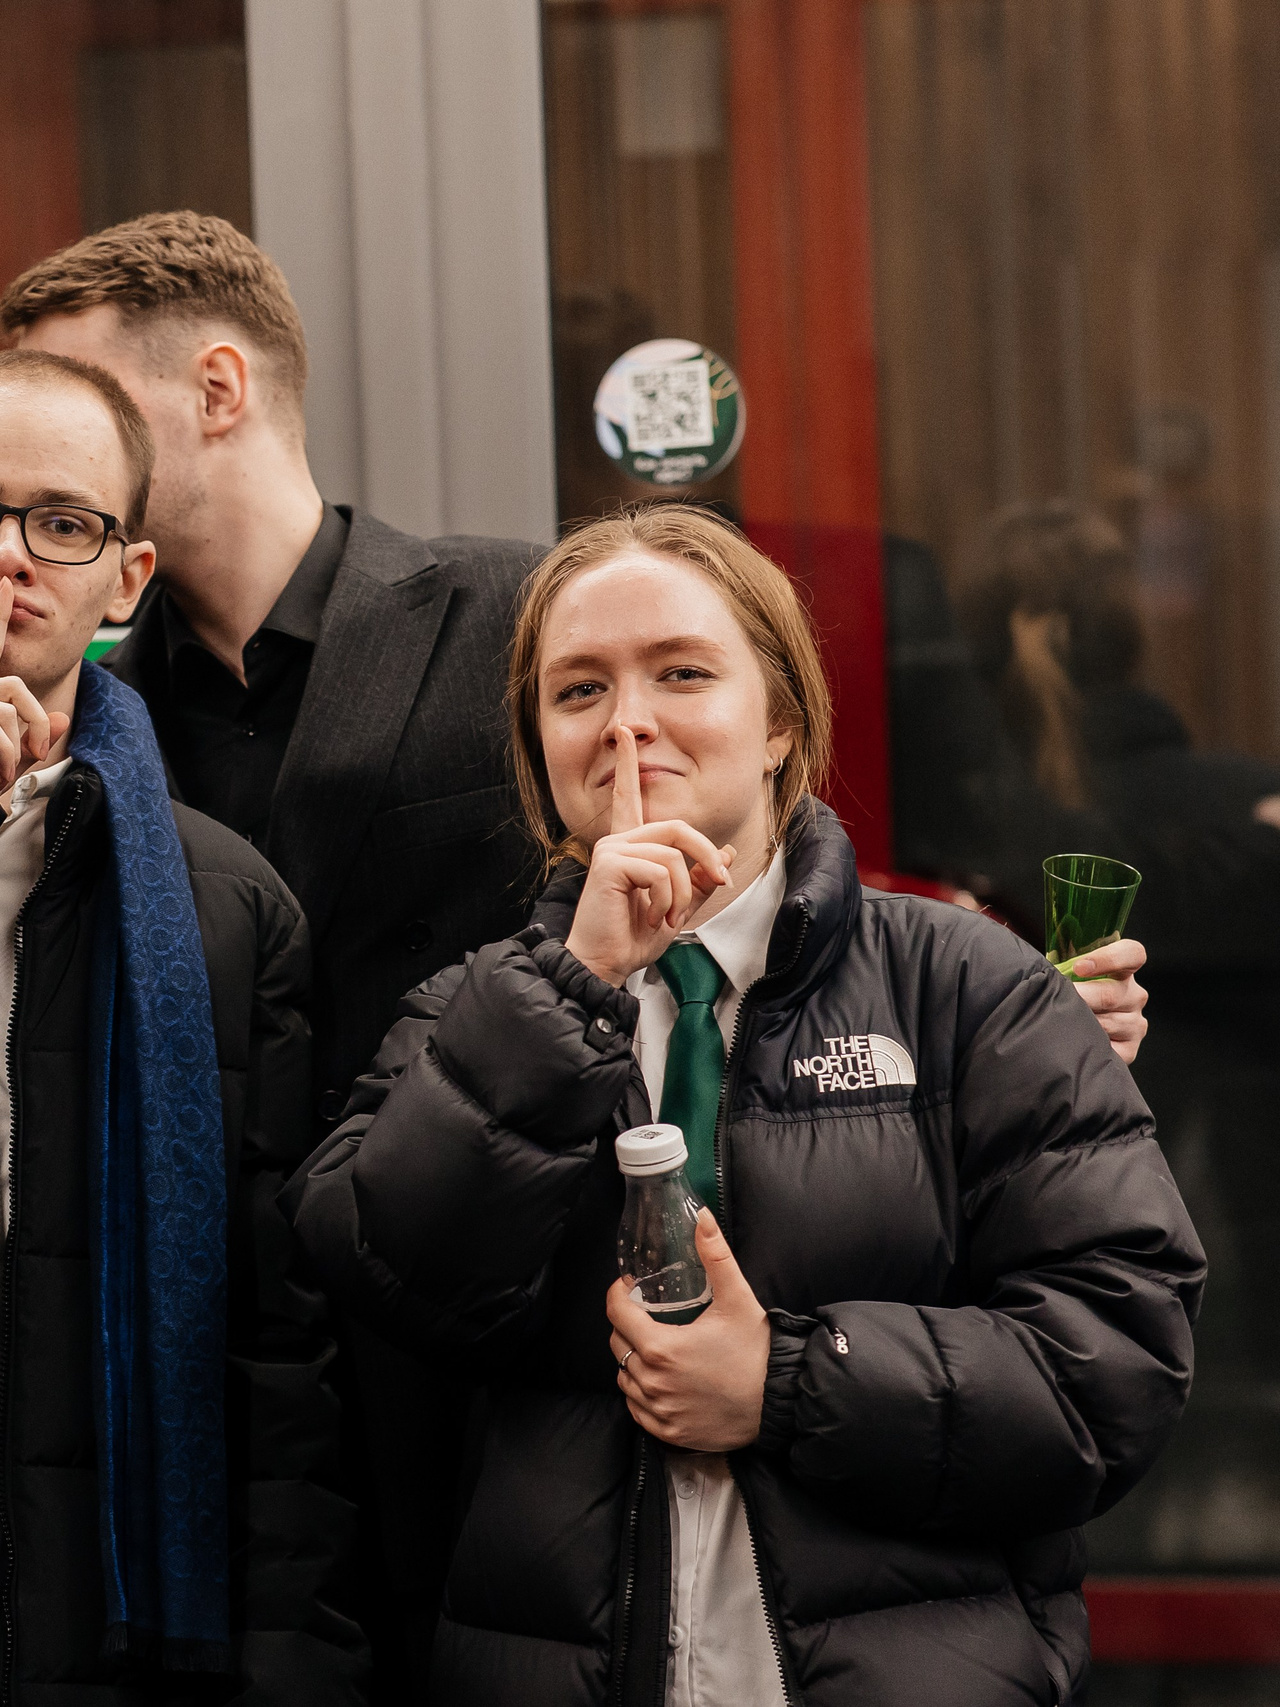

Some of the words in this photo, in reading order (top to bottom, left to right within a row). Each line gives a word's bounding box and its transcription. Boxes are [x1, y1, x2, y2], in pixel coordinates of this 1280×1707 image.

[824, 1035, 870, 1055] THE
[793, 1052, 873, 1078] NORTH
[817, 1070, 876, 1093] FACE
